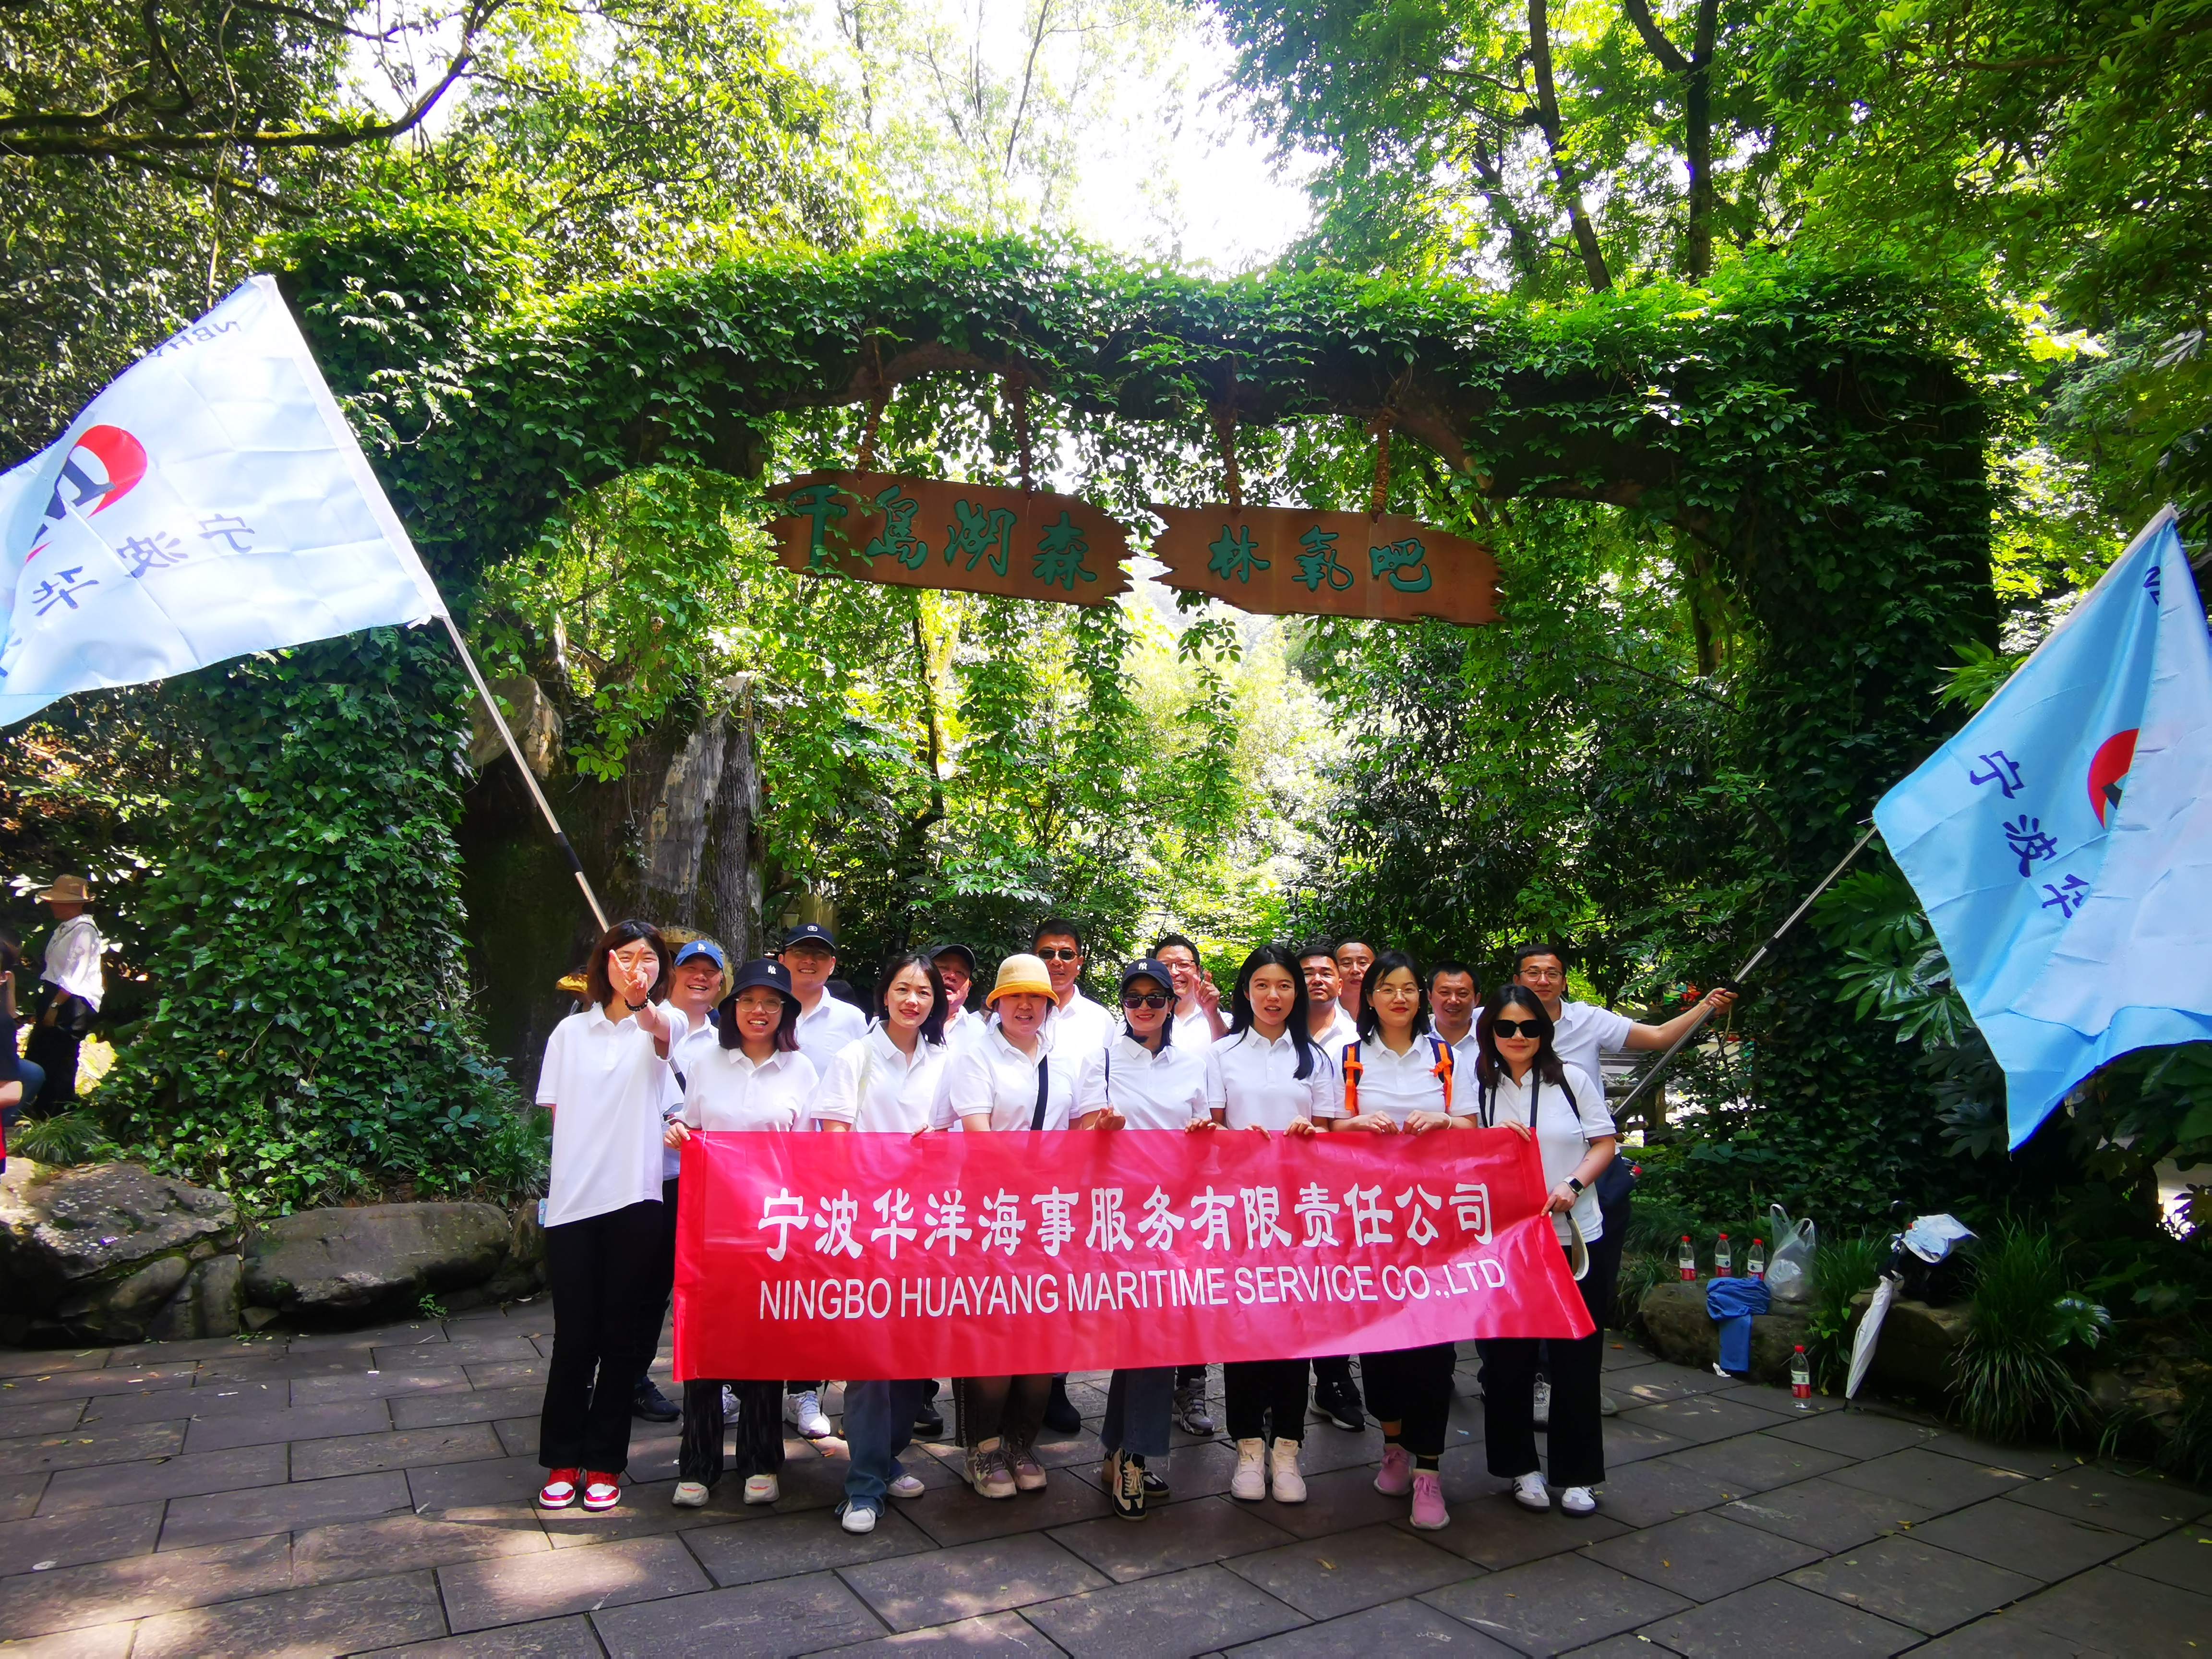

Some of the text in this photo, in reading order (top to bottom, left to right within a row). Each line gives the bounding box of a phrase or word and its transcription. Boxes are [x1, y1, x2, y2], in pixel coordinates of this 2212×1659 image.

[1207, 524, 1433, 593] 林氧吧
[757, 1182, 1493, 1262] 宁波华洋海事服务有限责任公司
[760, 1277, 891, 1320] NINGBO
[901, 1274, 1058, 1318] HUAYANG
[1067, 1268, 1229, 1311] MARITIME
[1234, 1265, 1379, 1305] SERVICE
